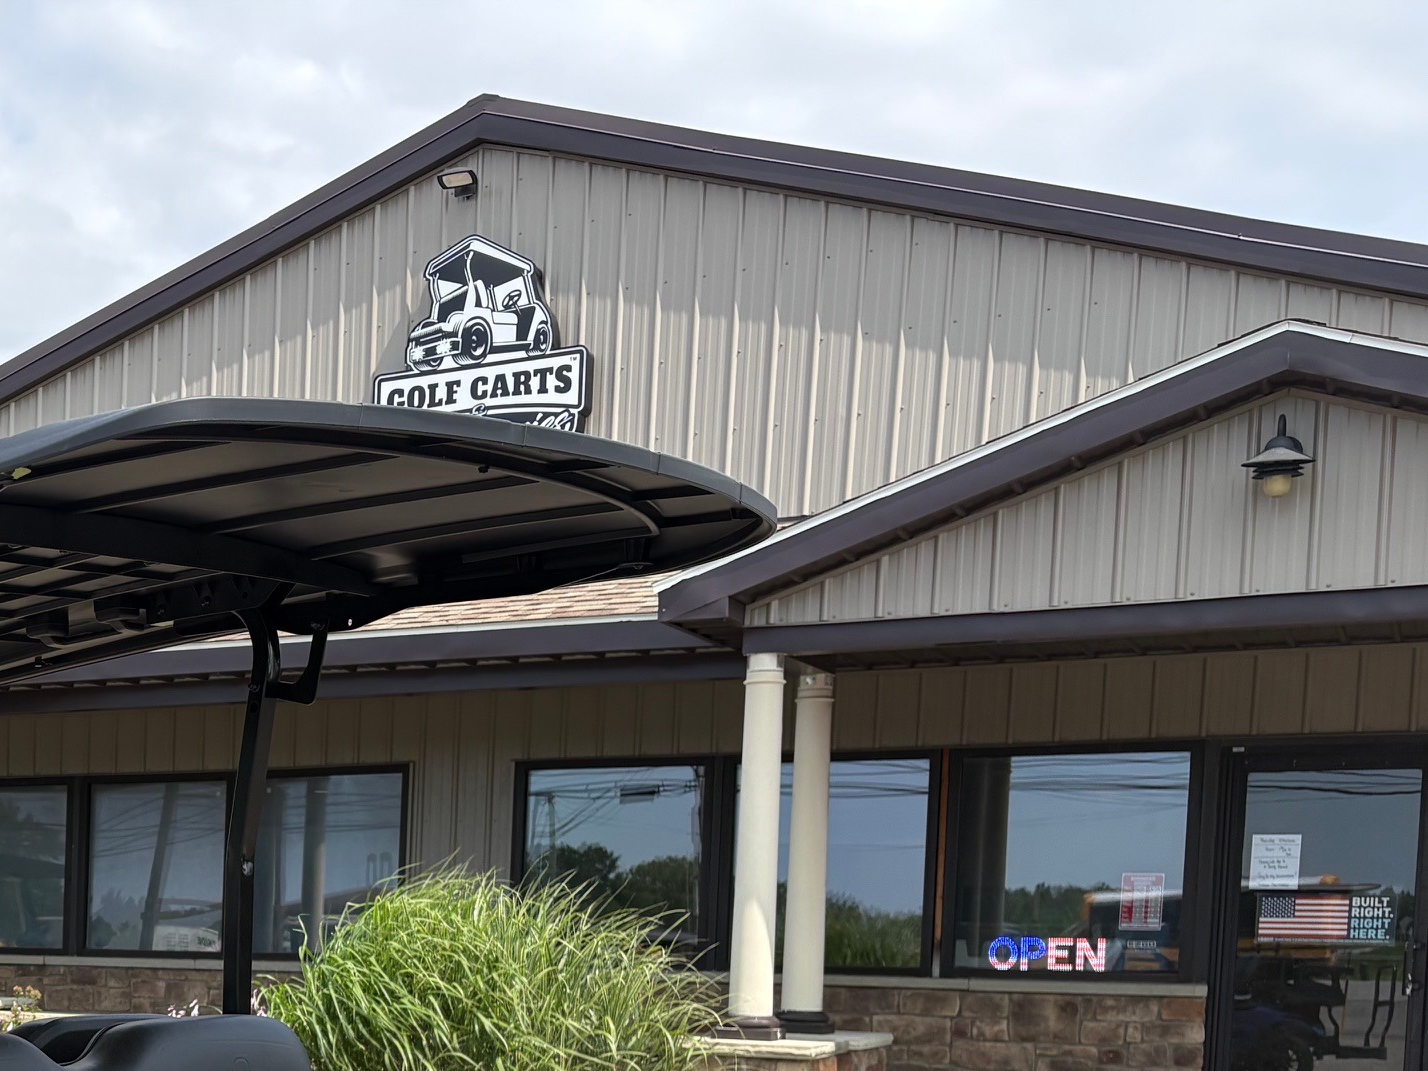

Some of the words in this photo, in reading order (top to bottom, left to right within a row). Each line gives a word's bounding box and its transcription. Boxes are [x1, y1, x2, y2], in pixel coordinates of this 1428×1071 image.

[387, 379, 461, 408] GOLF
[470, 364, 573, 400] CARTS
[1352, 897, 1390, 907] BUILT
[1351, 907, 1394, 918] RIGHT.
[1350, 918, 1391, 928] RIGHT
[1349, 929, 1390, 939] HERE.
[988, 936, 1106, 972] OPEN
